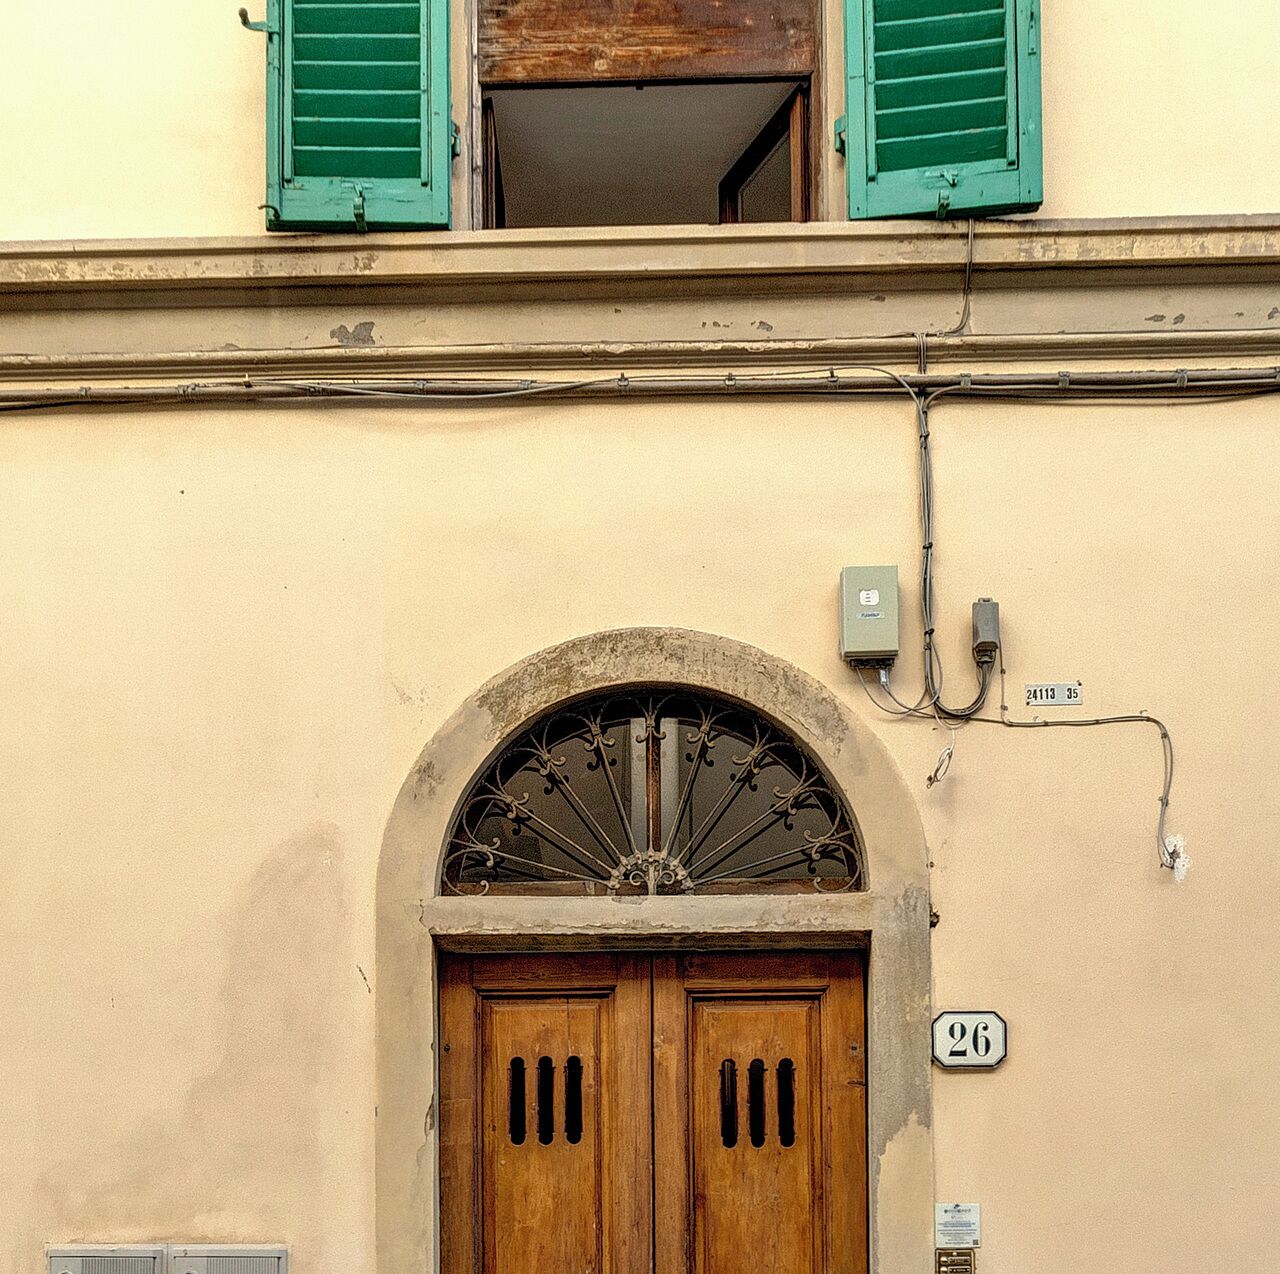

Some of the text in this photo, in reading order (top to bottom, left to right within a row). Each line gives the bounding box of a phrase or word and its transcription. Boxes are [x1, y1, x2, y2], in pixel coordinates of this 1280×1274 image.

[1026, 687, 1079, 701] 24113 35
[948, 1021, 991, 1057] 26
